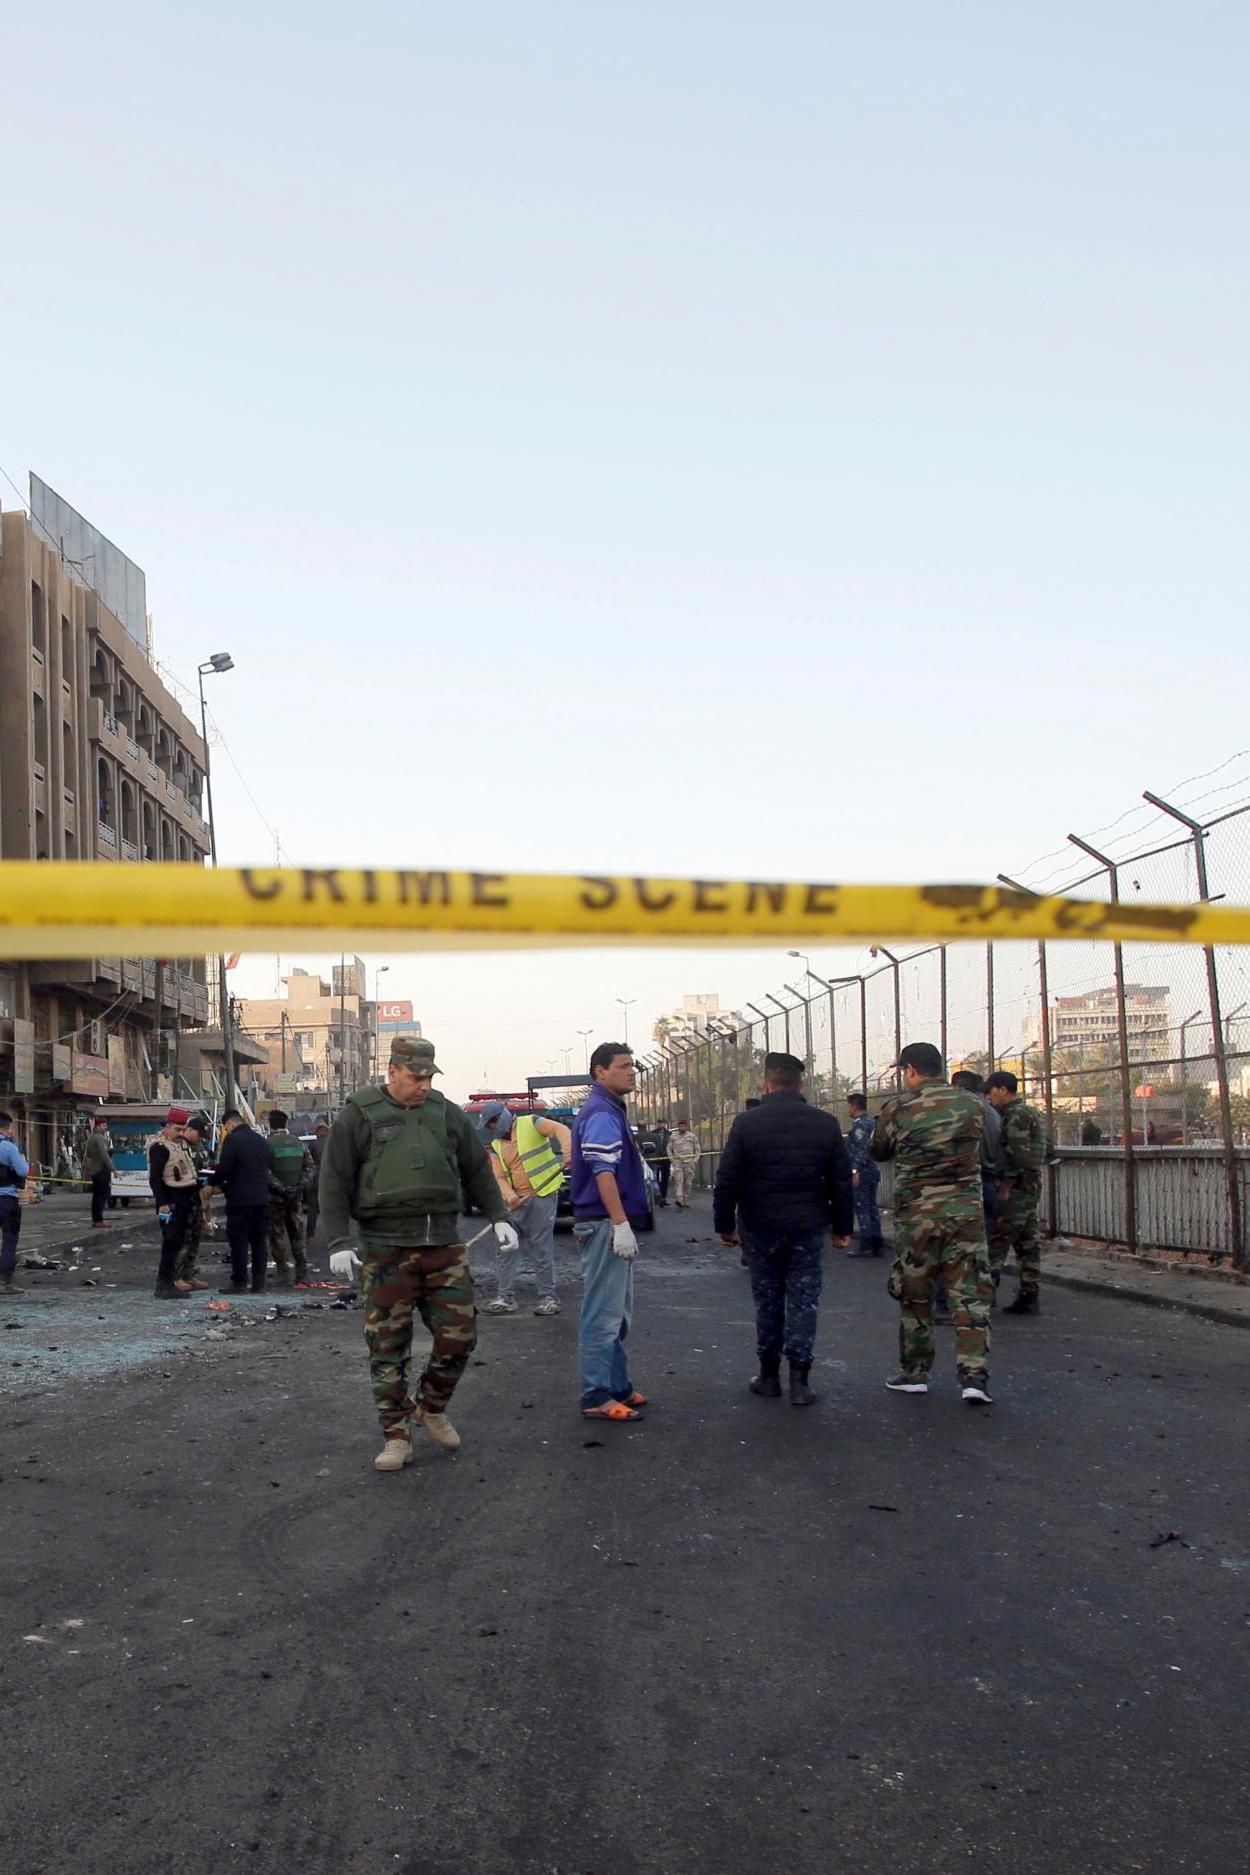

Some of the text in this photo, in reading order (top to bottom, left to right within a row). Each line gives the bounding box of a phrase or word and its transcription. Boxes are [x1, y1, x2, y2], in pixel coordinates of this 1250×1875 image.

[237, 868, 841, 914] CRIME SCENE
[383, 1005, 402, 1017] LG
